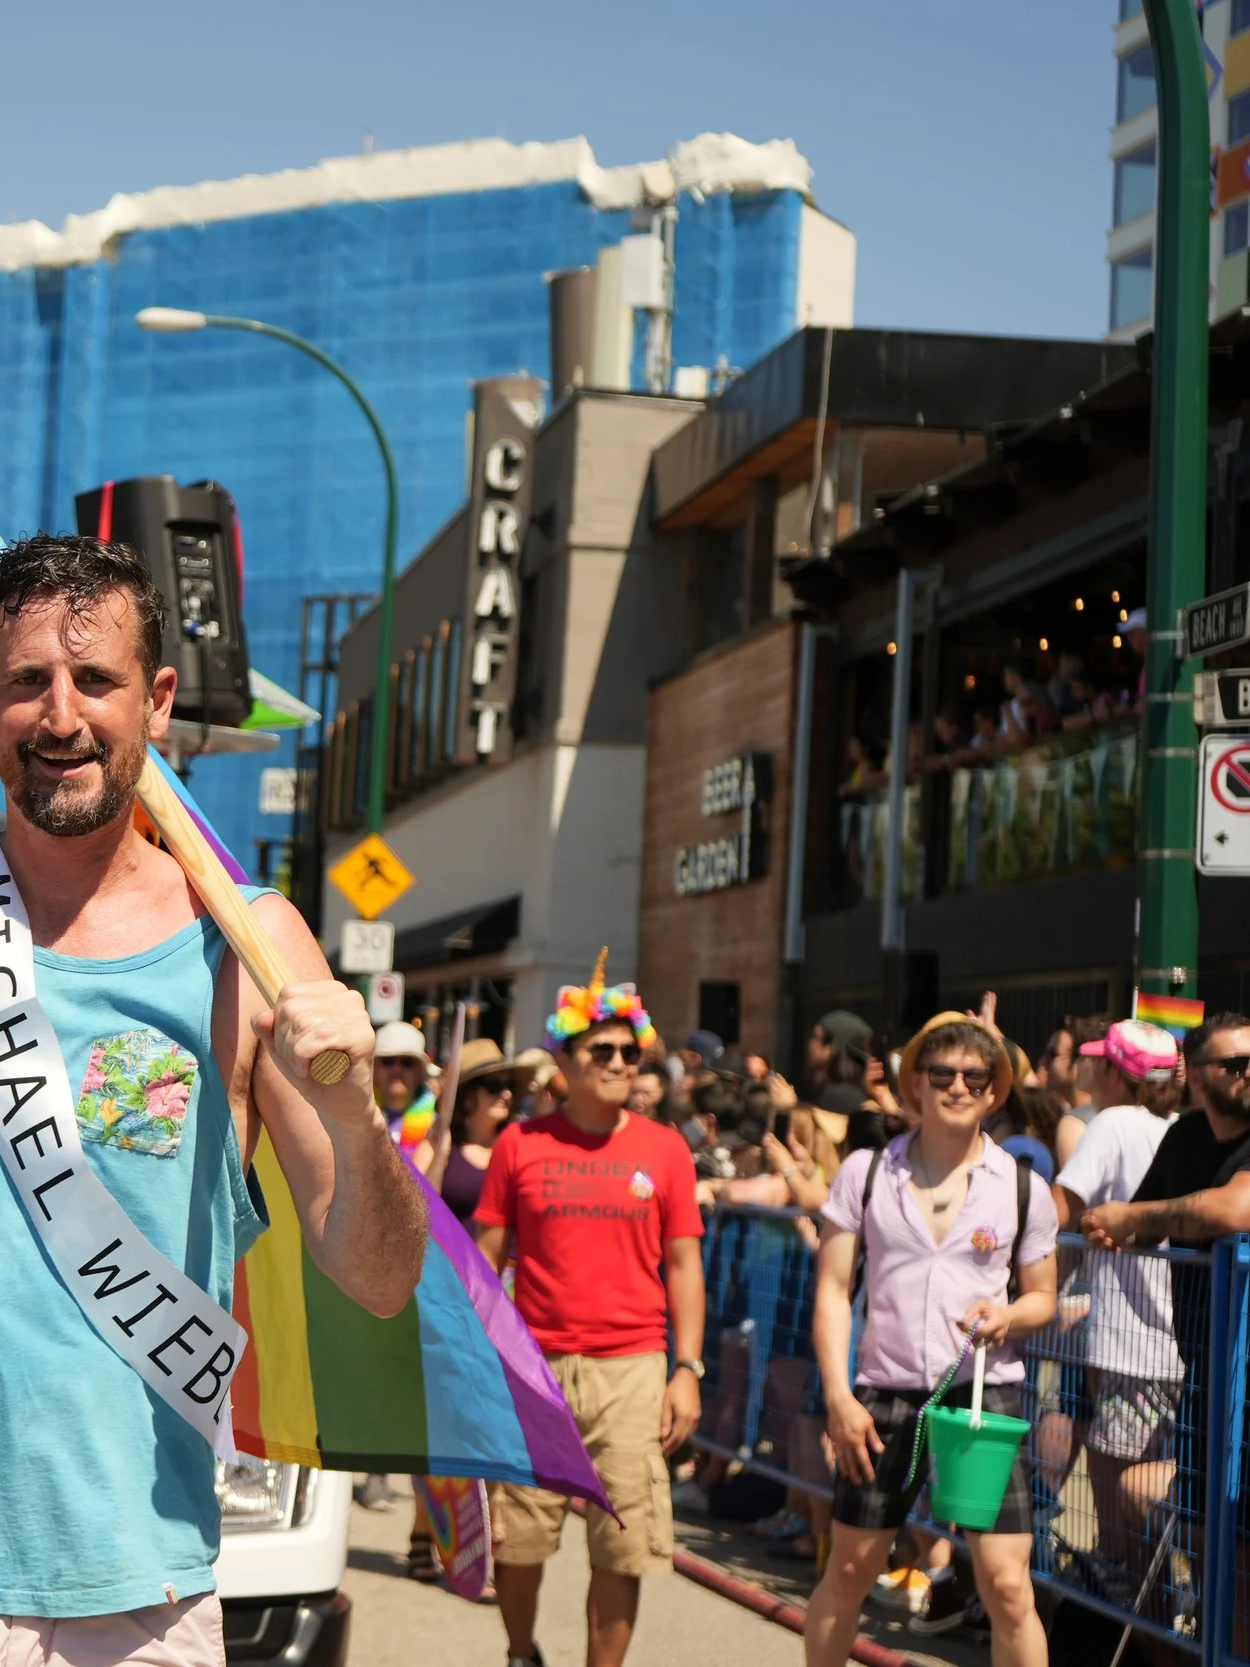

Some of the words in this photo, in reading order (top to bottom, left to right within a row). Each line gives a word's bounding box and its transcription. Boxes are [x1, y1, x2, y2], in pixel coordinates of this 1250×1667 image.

[471, 438, 527, 754] CRAFT
[1192, 600, 1226, 649] BEACH
[702, 759, 742, 817] BEER
[675, 833, 739, 896] GARDEN
[540, 1203, 650, 1221] ARMOUR
[77, 1237, 236, 1425] WIEB
